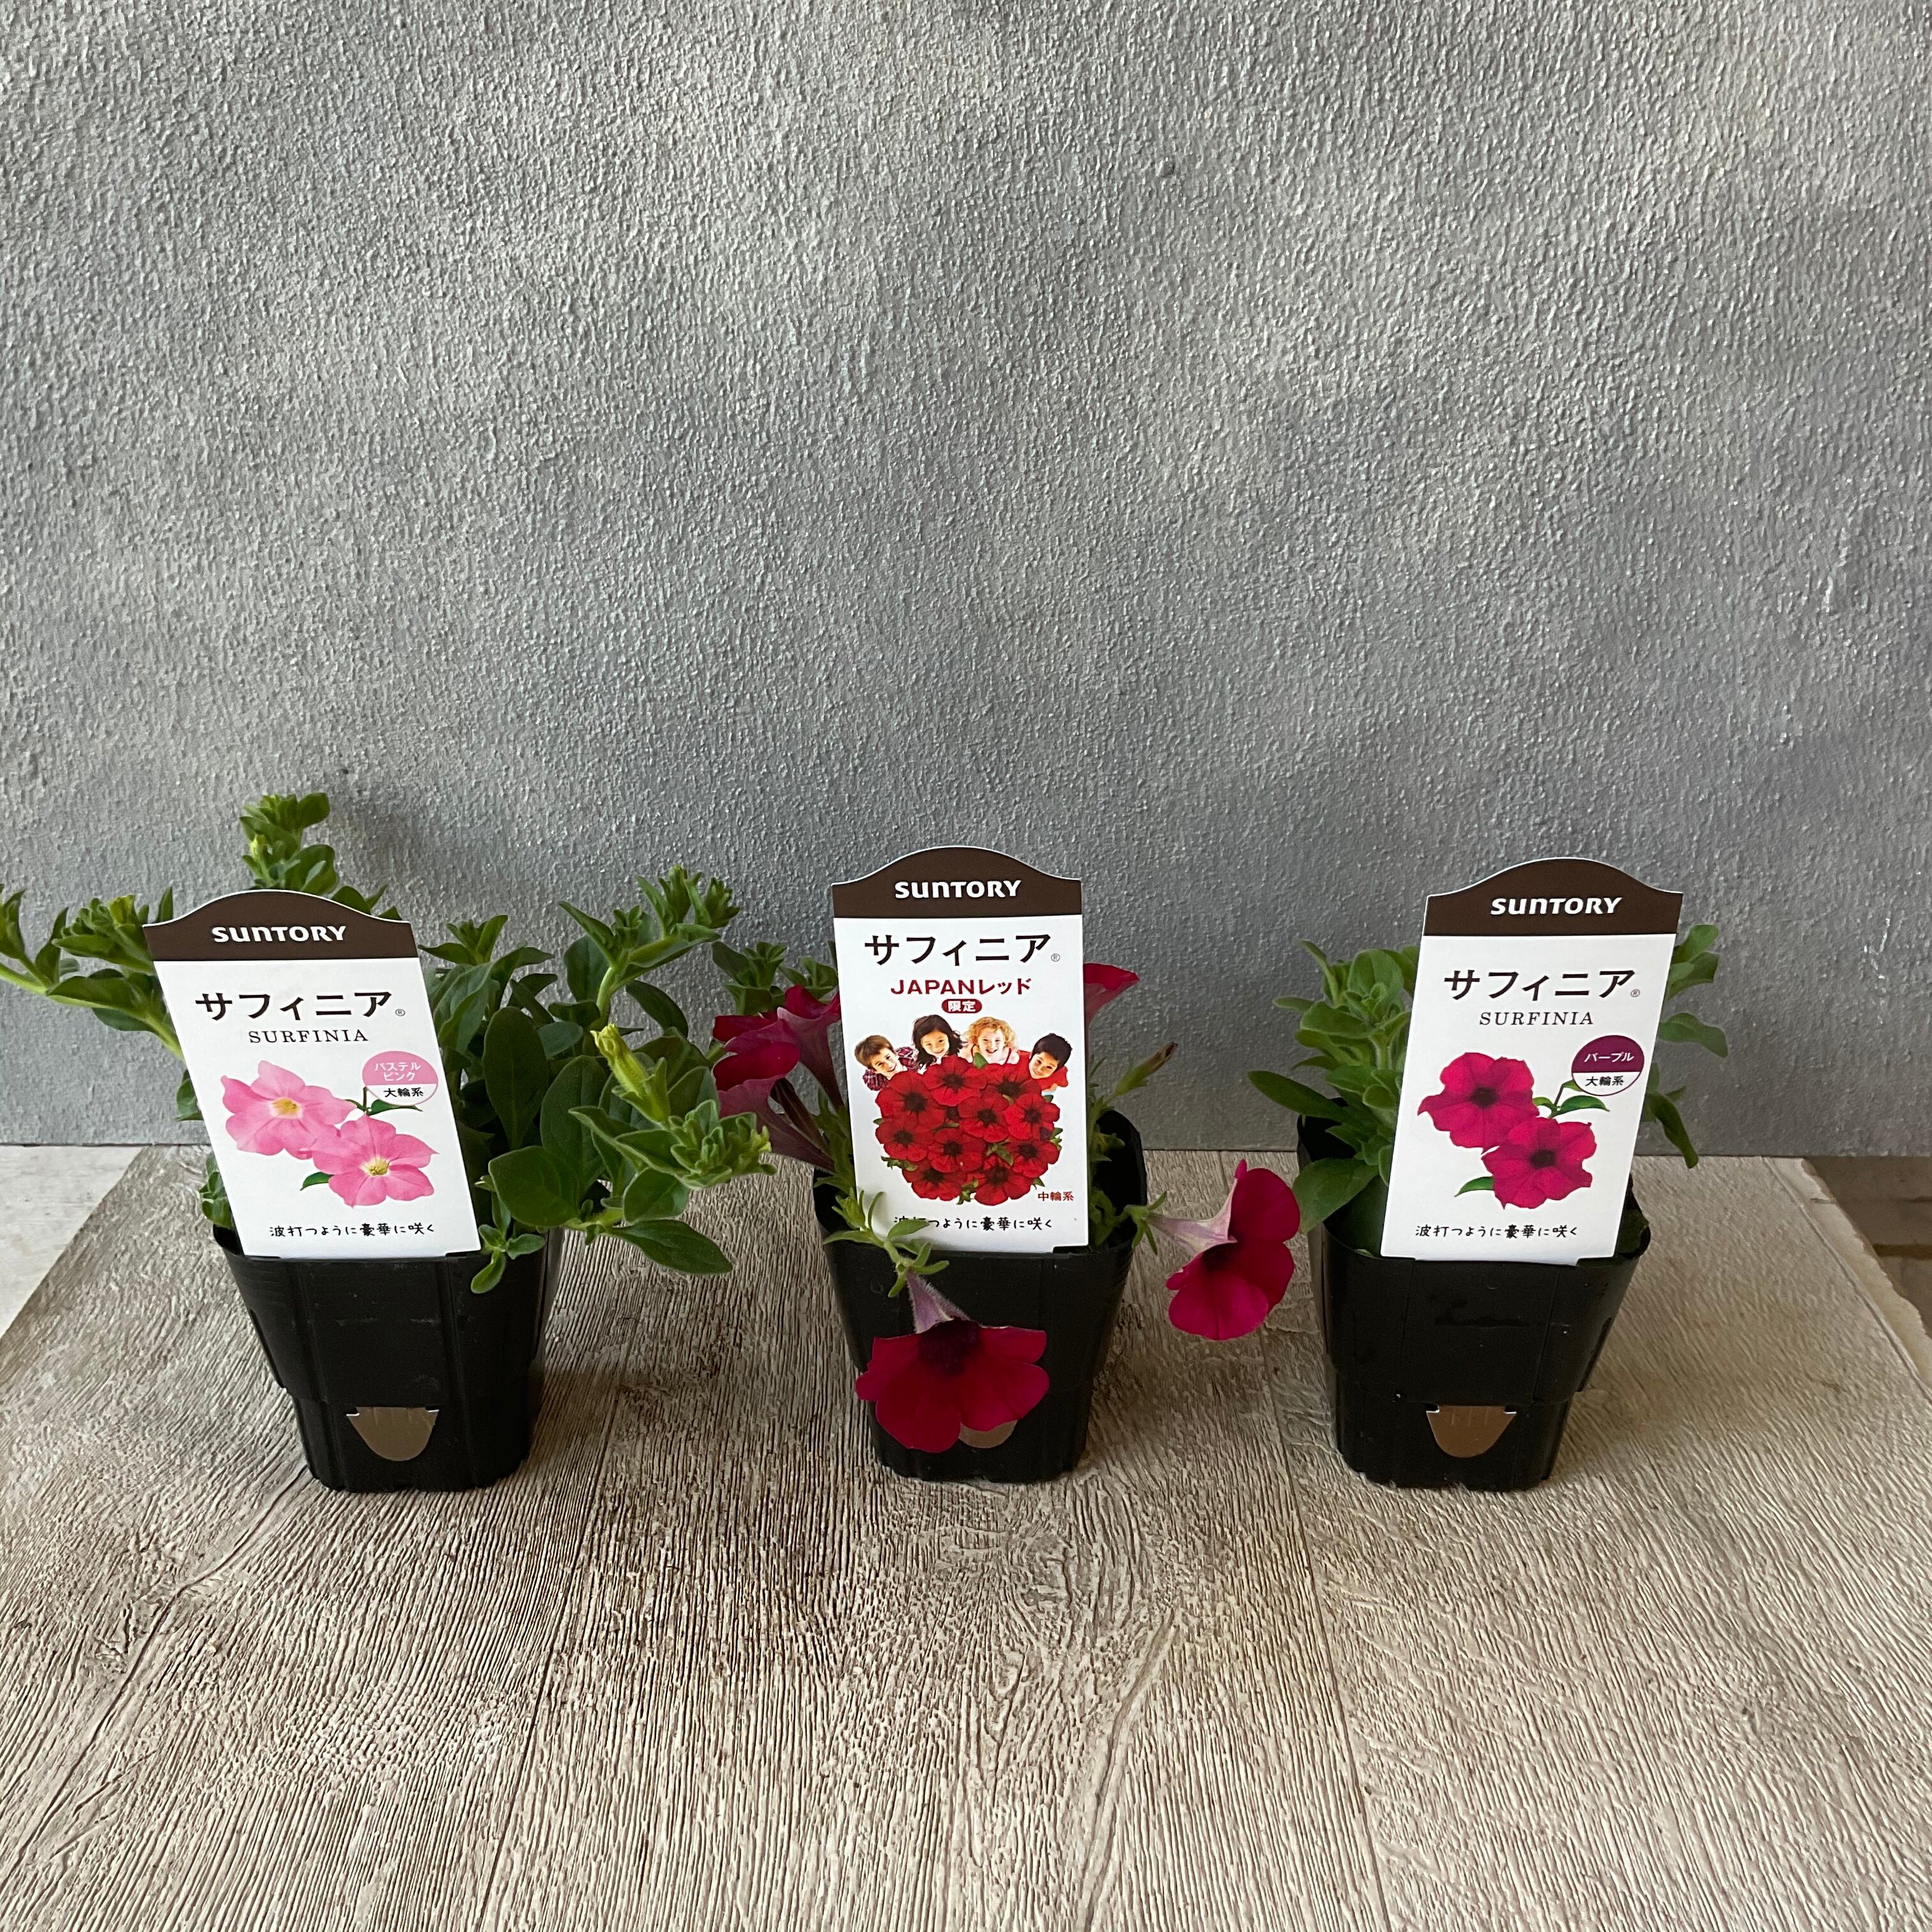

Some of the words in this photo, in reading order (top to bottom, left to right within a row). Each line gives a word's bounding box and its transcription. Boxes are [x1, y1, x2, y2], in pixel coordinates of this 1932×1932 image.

[895, 880, 1021, 898] SUNTORY
[1491, 898, 1621, 914] SUNTORY
[212, 926, 346, 942] SUNTORY
[891, 978, 1031, 995] JAPANレッド
[947, 999, 976, 1013] 限定
[1480, 1012, 1593, 1025] SURFINIA
[249, 1029, 368, 1043] SURFINIA
[1585, 1076, 1623, 1086] 大輪系
[383, 1087, 424, 1098] 大輪系
[1038, 1192, 1073, 1201] 中輪系
[270, 1222, 434, 1237] 波打つように豪華に咲く
[893, 1215, 1054, 1232] つように豪華に咲く
[1416, 1224, 1577, 1239] 波打つように豪華に咲く
